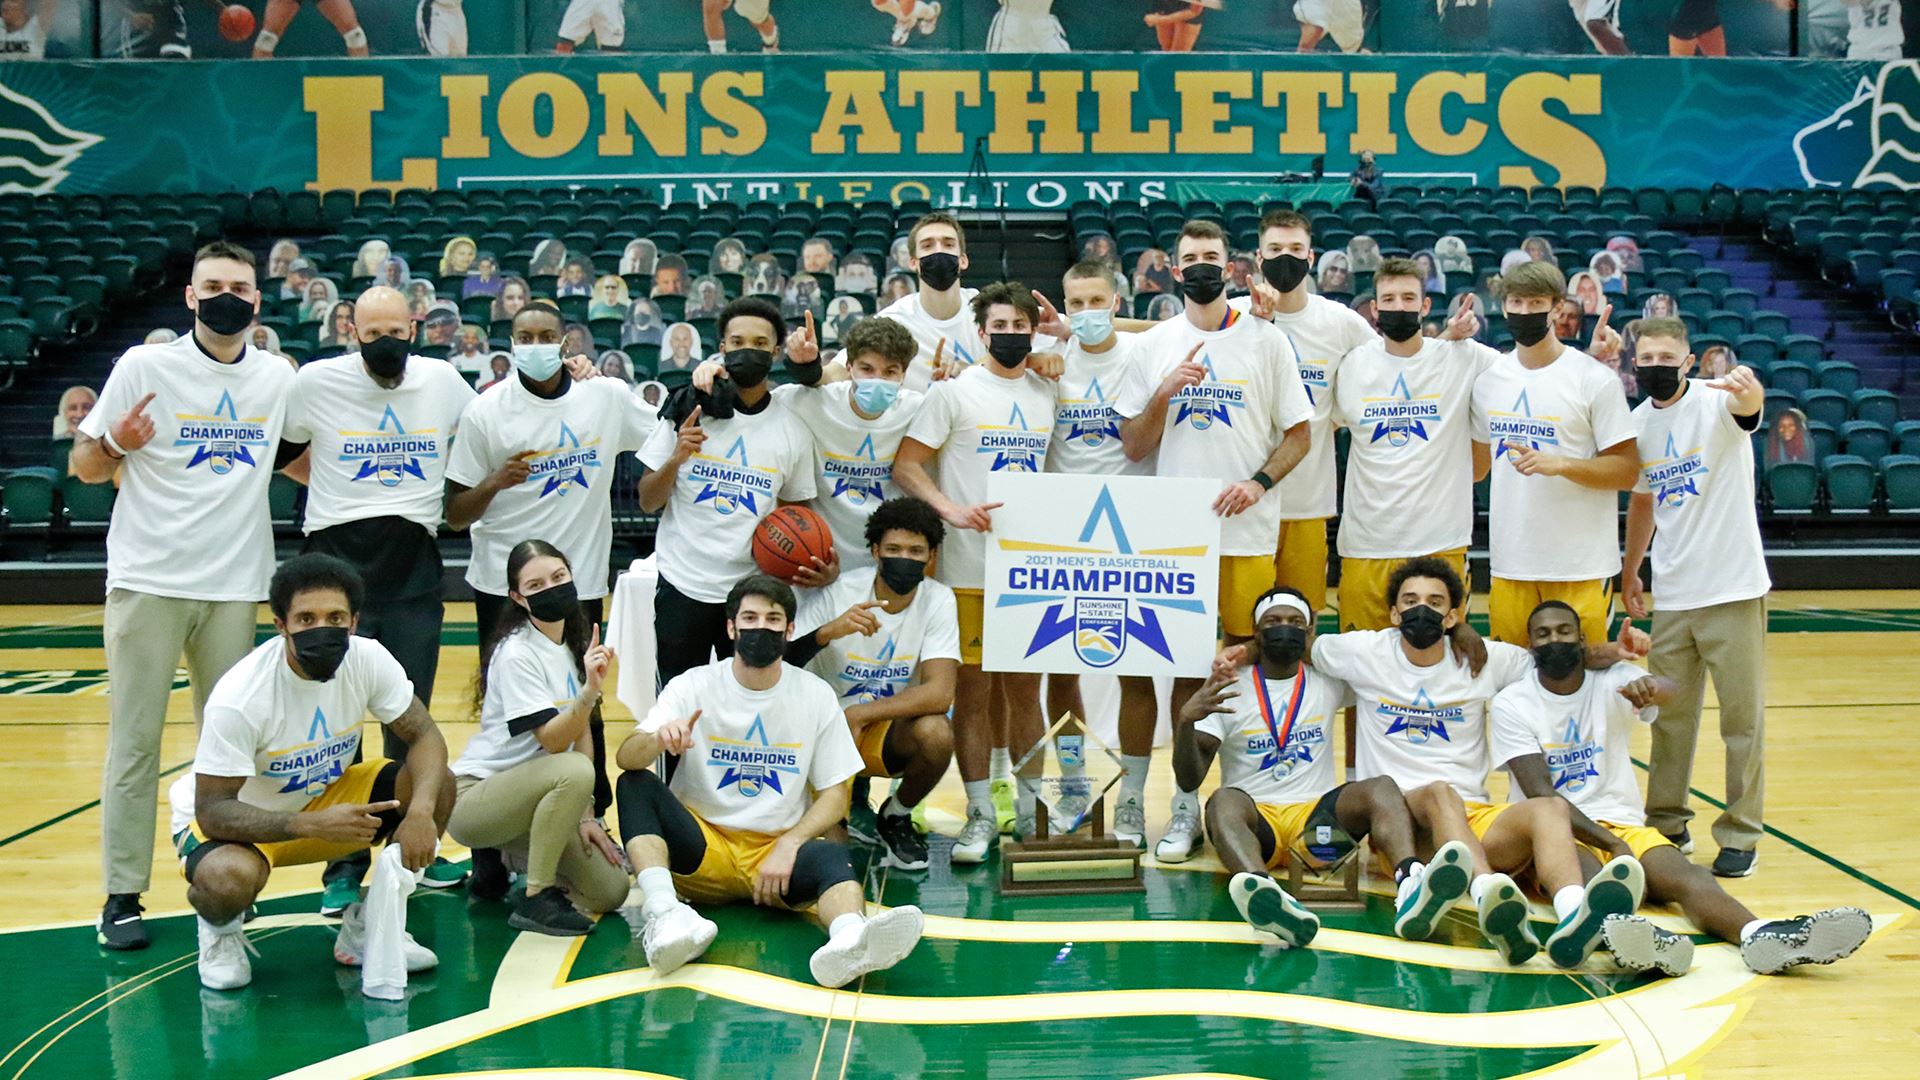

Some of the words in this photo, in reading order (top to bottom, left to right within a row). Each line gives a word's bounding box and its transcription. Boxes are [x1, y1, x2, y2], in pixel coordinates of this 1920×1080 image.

[303, 71, 768, 207] LIONS
[810, 70, 1607, 205] ATHLETICS
[1170, 386, 1243, 401] AMPIONS
[1363, 404, 1438, 418] CHAMPIONS
[180, 426, 265, 441] CHAMPIONS
[1489, 421, 1555, 438] CHAMPIONS
[343, 440, 436, 454] CHAMPIONS
[981, 436, 1047, 449] CHAMPIONS
[692, 464, 773, 490] CHAMPIONS
[1025, 555, 1053, 565] 2021
[1056, 556, 1095, 567] MEN'S
[1098, 557, 1180, 569] BASKETBALL
[1008, 567, 1195, 595] CHAMPIONS
[1079, 601, 1124, 610] SUNSHINE
[1087, 610, 1114, 618] STATE
[1247, 726, 1323, 750] CHAPIONS
[269, 734, 358, 772] CHAMPIONS
[711, 748, 797, 766] CHAMPIONS
